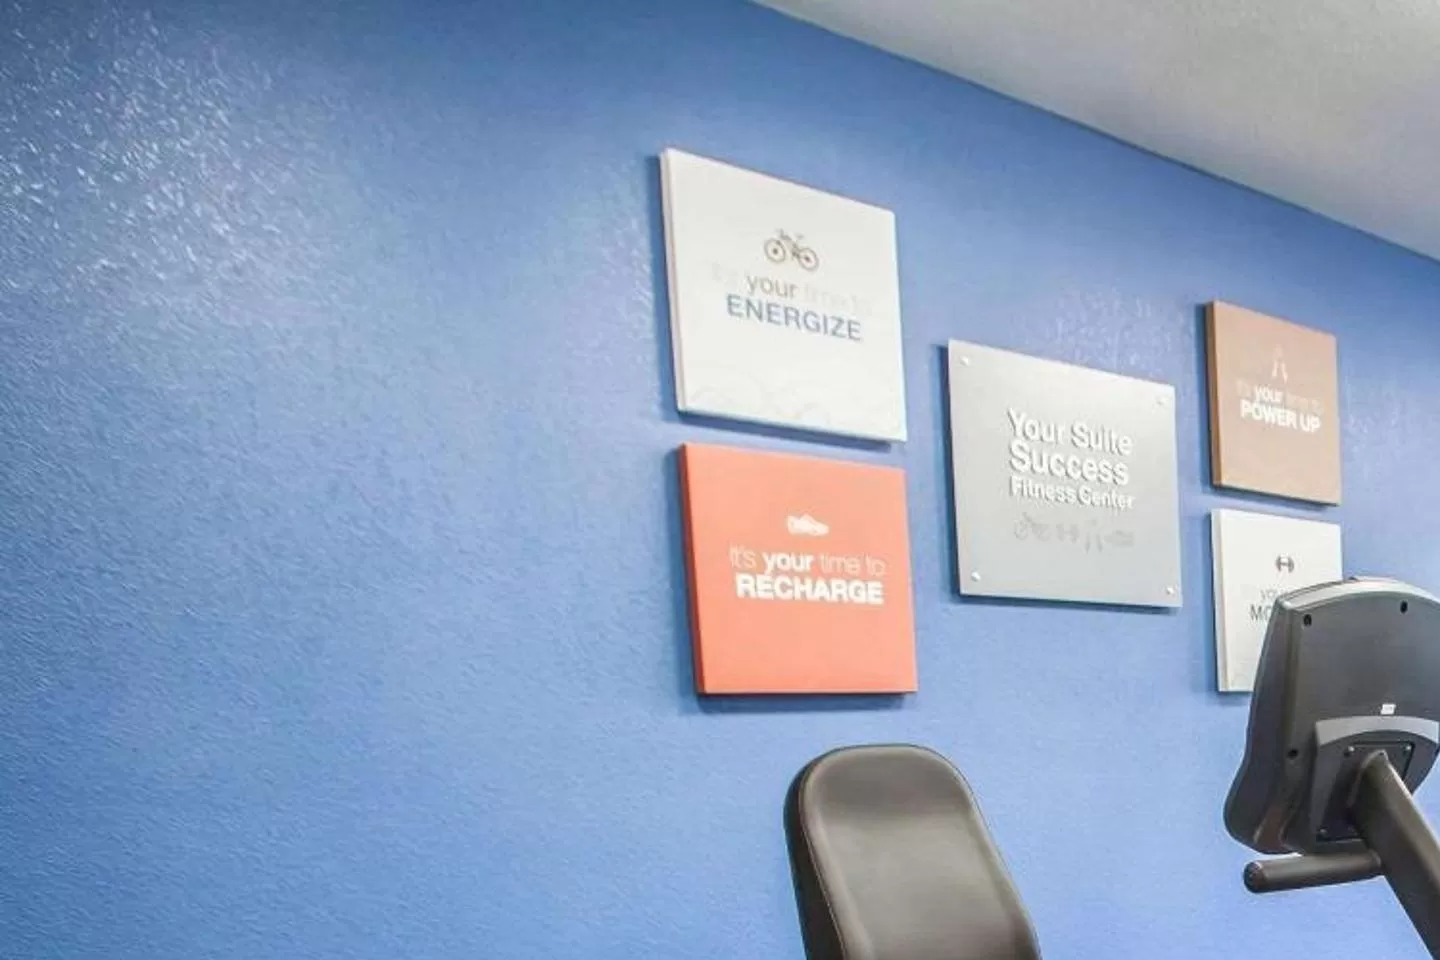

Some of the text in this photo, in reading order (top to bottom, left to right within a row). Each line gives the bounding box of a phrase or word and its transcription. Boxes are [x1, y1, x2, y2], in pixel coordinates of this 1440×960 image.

[746, 274, 799, 299] your
[726, 293, 862, 342] ENERGIZE
[1007, 408, 1133, 456] Your Suite
[1240, 398, 1297, 430] POWER
[1299, 412, 1321, 433] UP
[1009, 440, 1129, 486] Success
[1009, 475, 1135, 510] Fitness Center
[762, 551, 815, 575] your
[820, 553, 861, 576] time
[865, 554, 886, 577] to
[735, 573, 885, 605] RECHARGE
